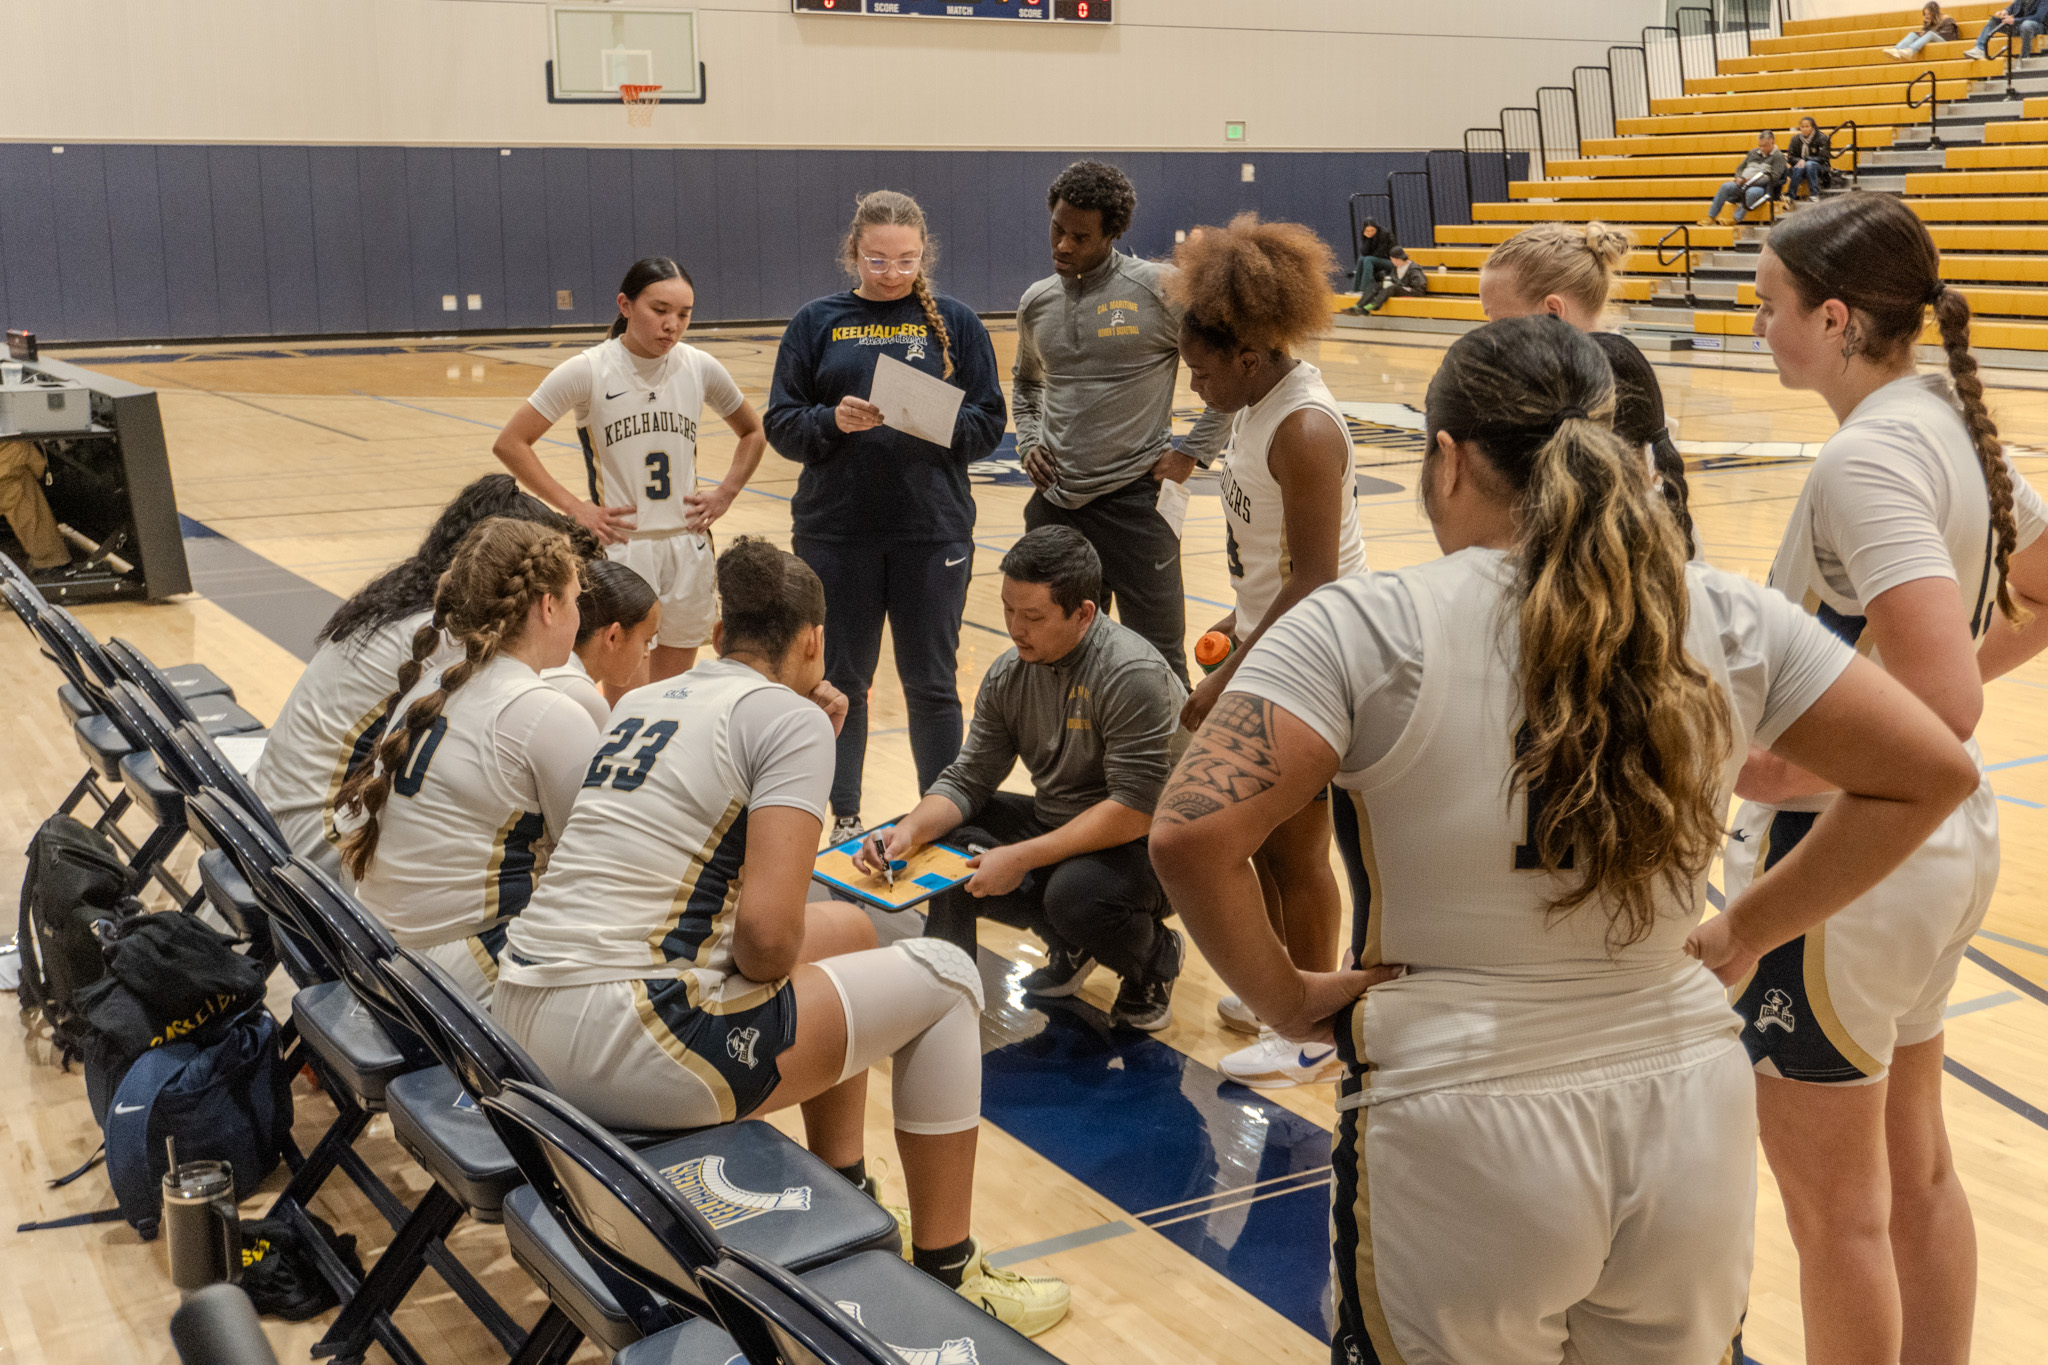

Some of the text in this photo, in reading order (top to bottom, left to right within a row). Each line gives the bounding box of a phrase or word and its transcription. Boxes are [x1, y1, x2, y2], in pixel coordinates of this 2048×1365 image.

[873, 2, 900, 13] SCORE
[946, 5, 974, 16] MATCH
[1018, 8, 1043, 18] SCORE
[1077, 2, 1089, 18] 0
[831, 323, 928, 342] KEELHAULERS
[604, 411, 697, 447] KEELHAULERS
[644, 450, 672, 501] 3
[581, 716, 681, 793] 23
